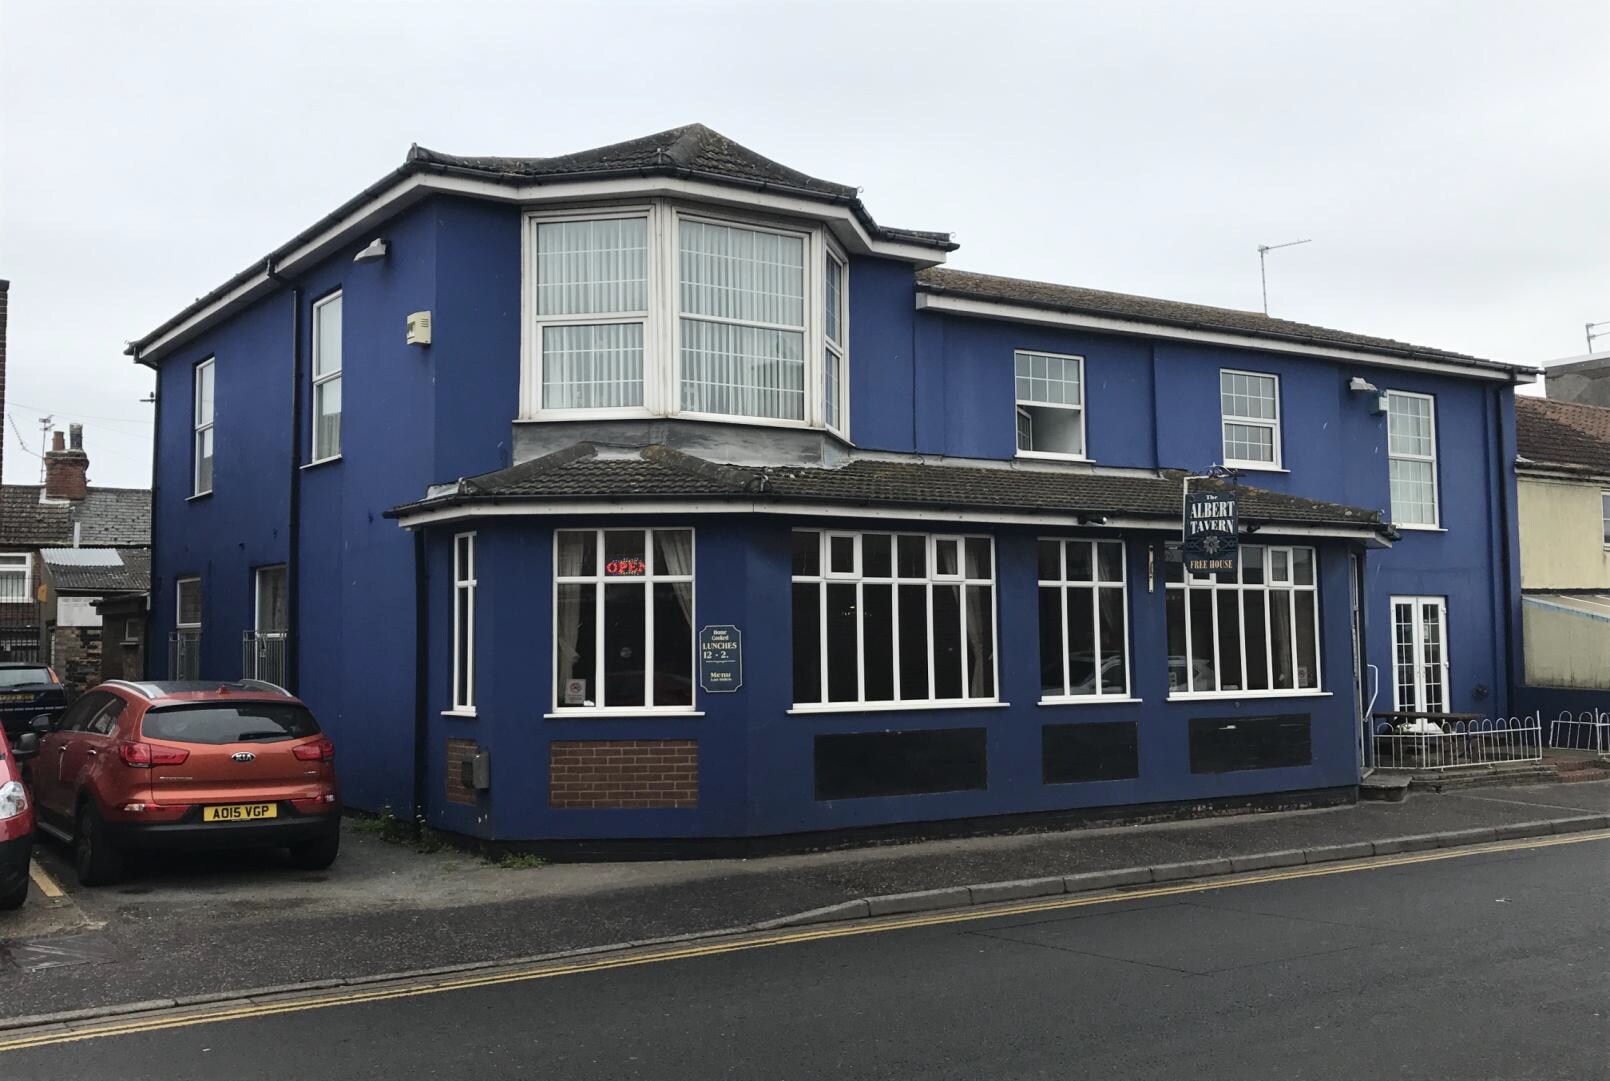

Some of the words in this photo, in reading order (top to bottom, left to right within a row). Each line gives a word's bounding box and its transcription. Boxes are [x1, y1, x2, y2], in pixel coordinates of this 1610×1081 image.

[1190, 501, 1235, 518] ALBERT
[1190, 520, 1234, 534] TAVERN
[1190, 560, 1208, 569] FREE
[1209, 560, 1233, 569] HOUSE
[702, 642, 737, 650] LUNCHES
[703, 651, 712, 659] 12
[213, 807, 241, 819] AO15
[245, 805, 269, 817] VGP
